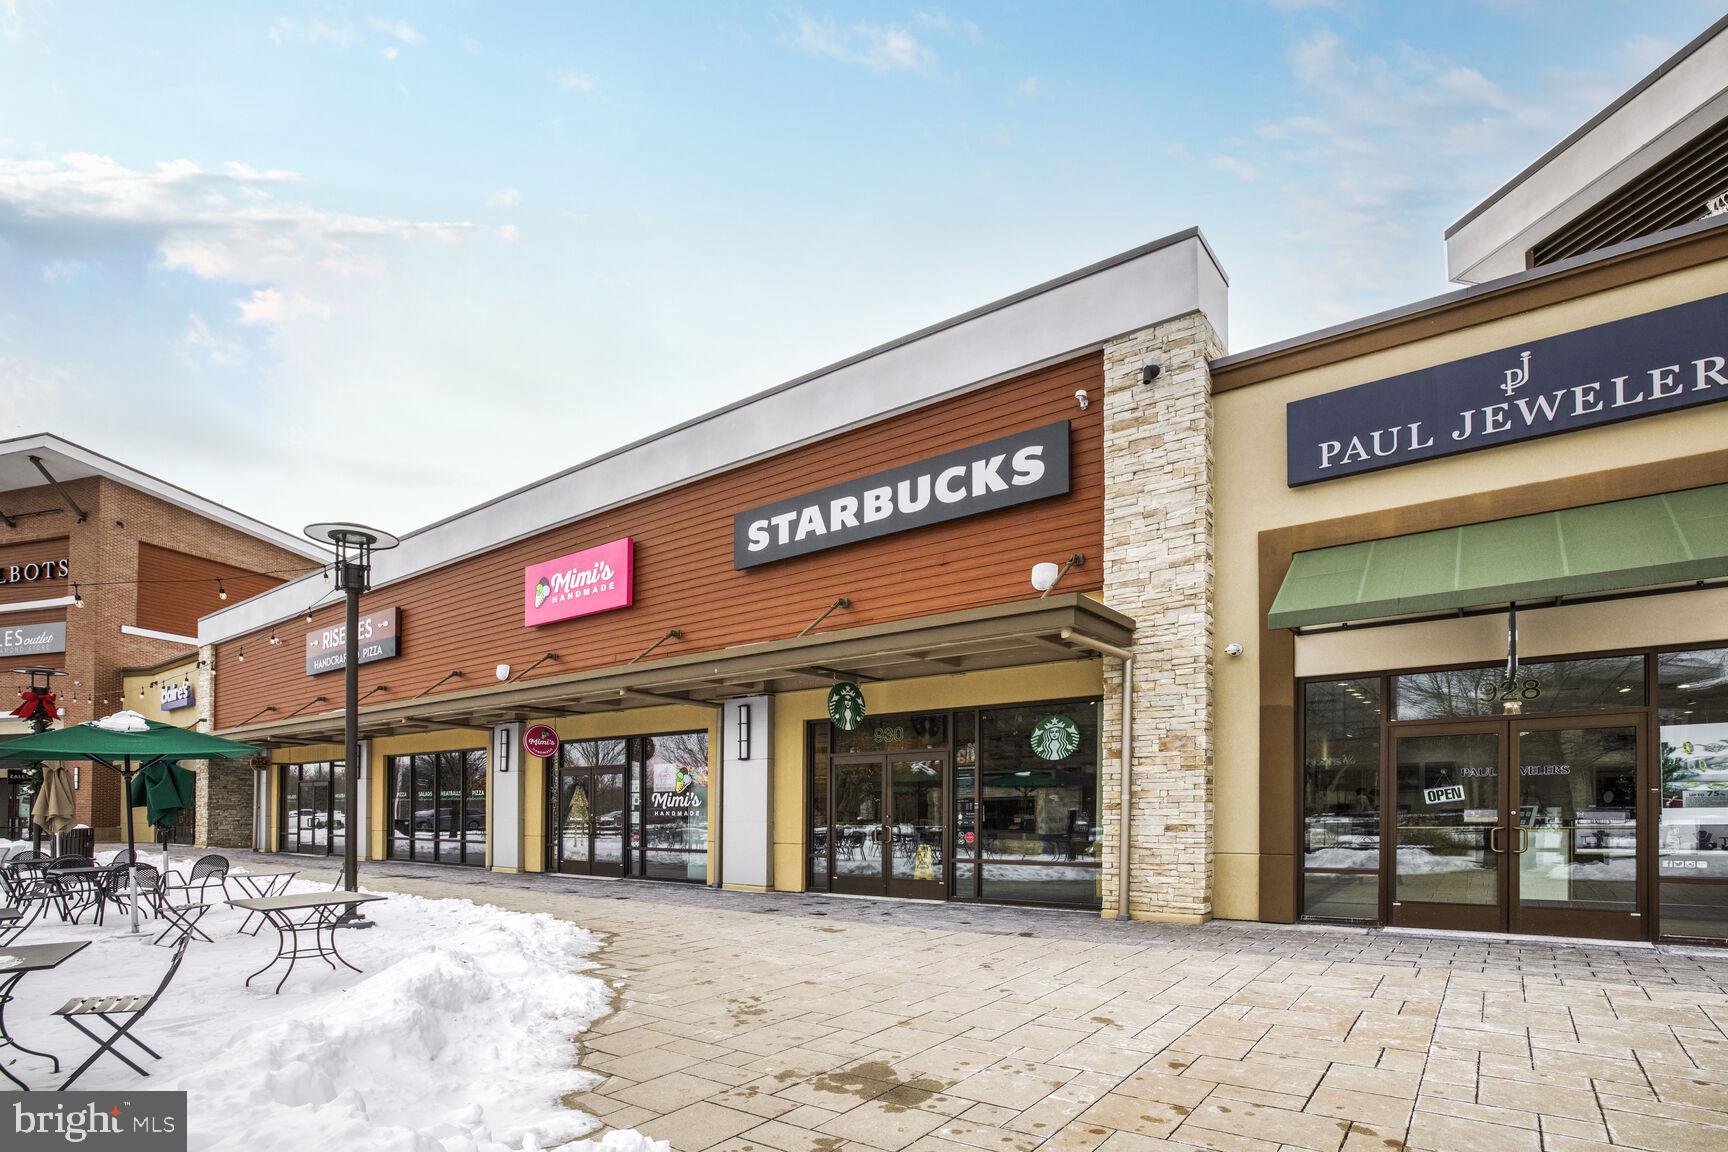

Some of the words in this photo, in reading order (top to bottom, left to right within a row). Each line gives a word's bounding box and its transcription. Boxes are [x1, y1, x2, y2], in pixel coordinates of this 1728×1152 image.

[1318, 422, 1434, 470] PAUL
[747, 446, 1046, 552] STARBUCKS
[551, 561, 615, 594] Mimi's
[552, 582, 615, 604] HANDMADE
[0, 629, 23, 647] ES
[322, 626, 346, 650] RISE
[363, 645, 383, 658] PIZZA
[1479, 680, 1540, 702] 928
[528, 737, 556, 746] Mimi's
[873, 726, 904, 743] 930
[1460, 767, 1497, 777] PAUL
[652, 792, 703, 809] Mimi's
[1427, 786, 1462, 802] OPEN
